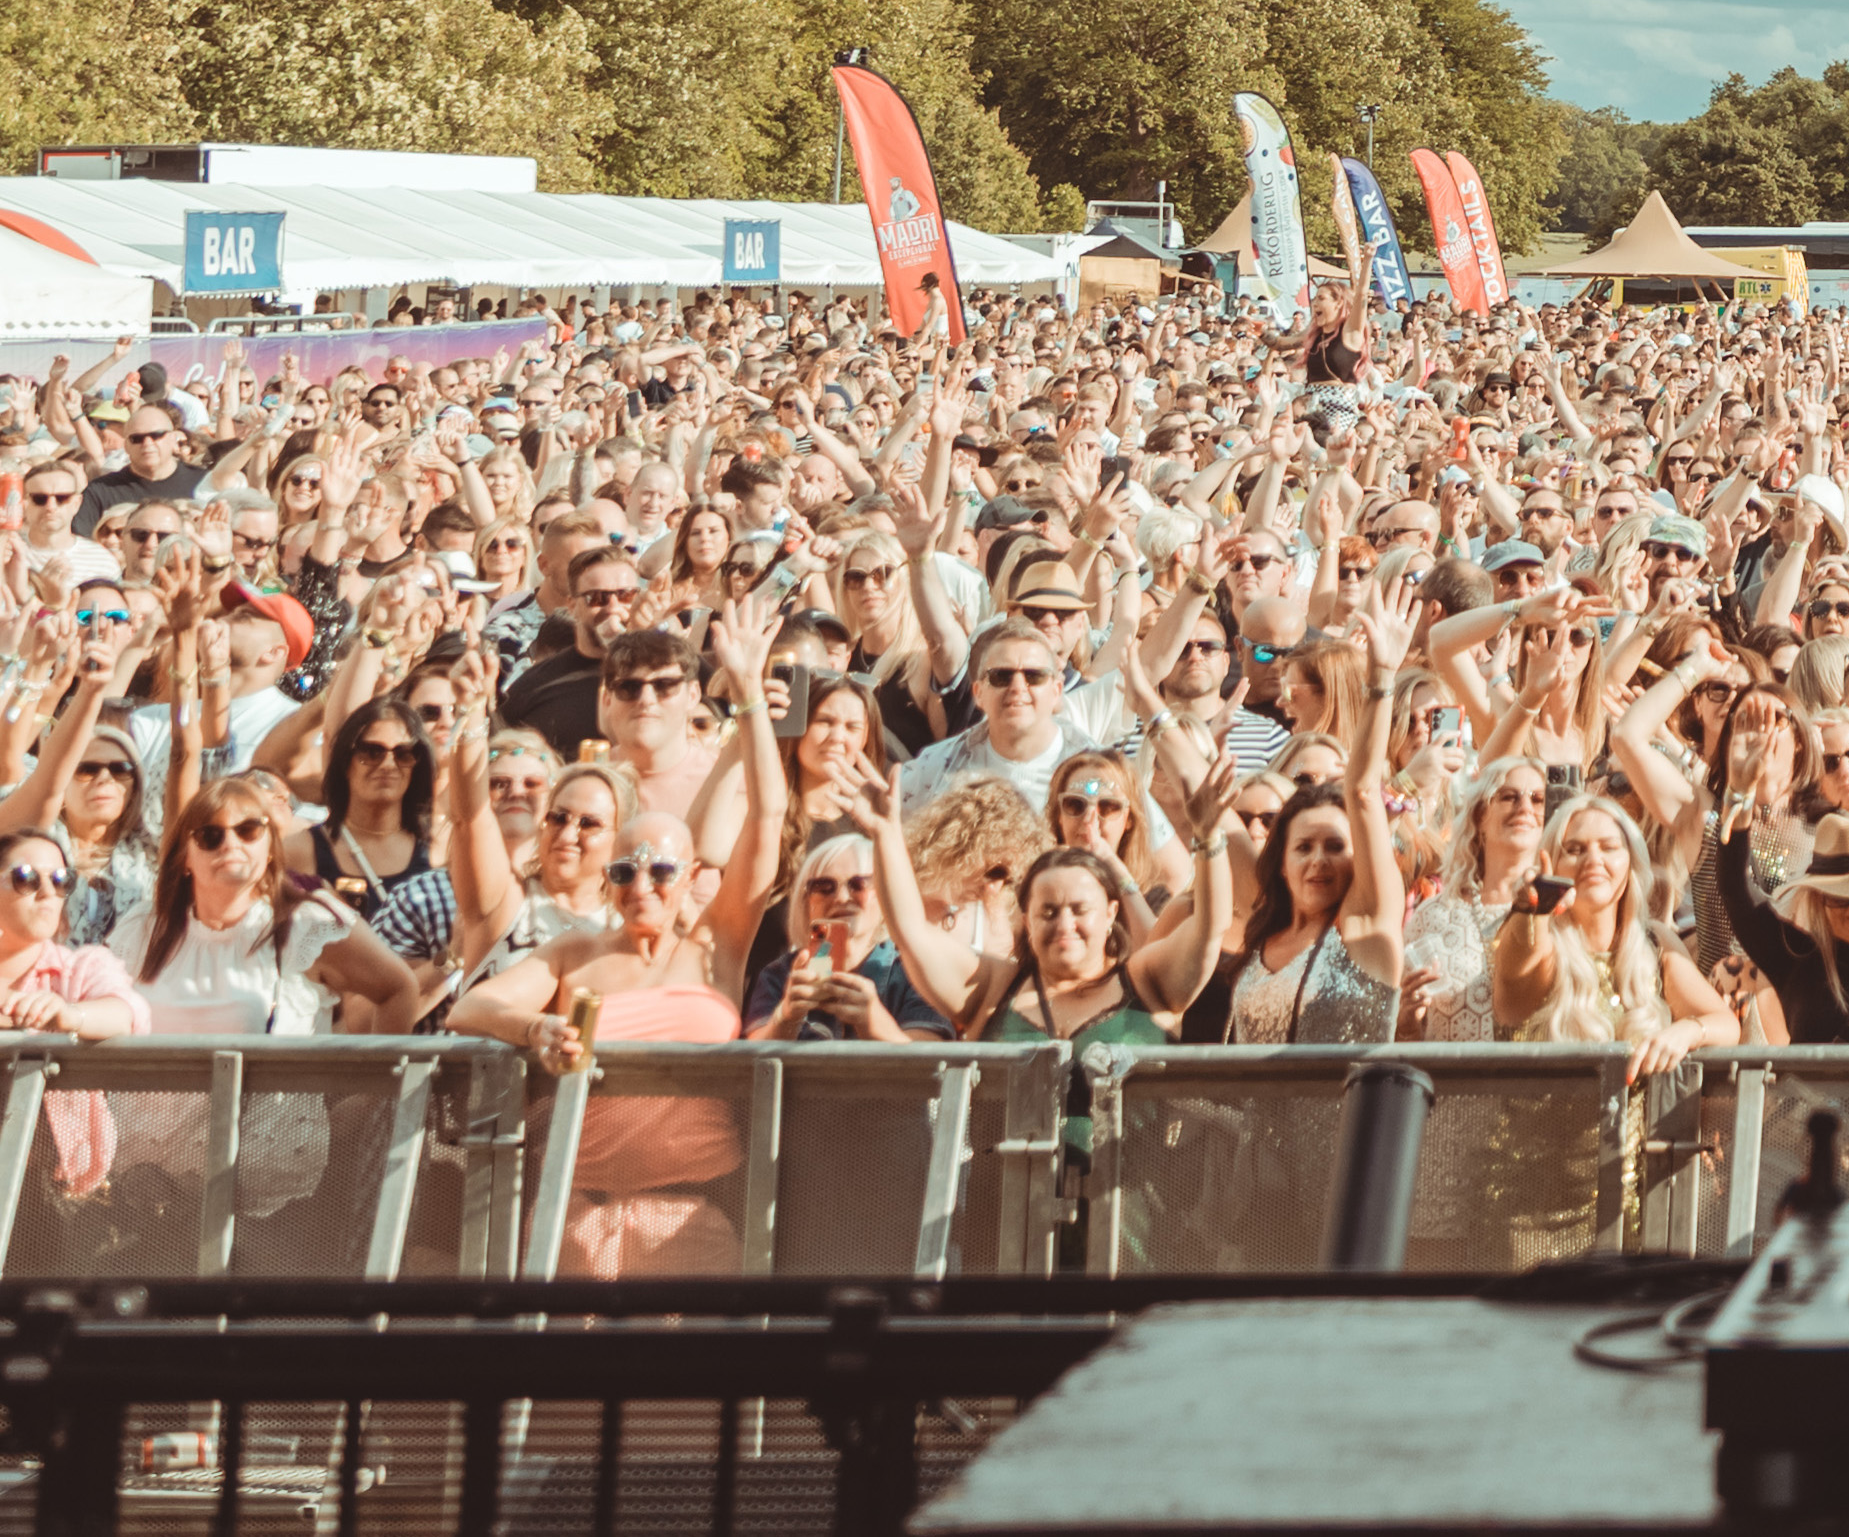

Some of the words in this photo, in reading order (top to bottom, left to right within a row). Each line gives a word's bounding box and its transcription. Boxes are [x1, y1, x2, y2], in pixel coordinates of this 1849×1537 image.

[1260, 170, 1284, 279] REKORDERLIG
[1361, 189, 1392, 248] BAR
[1461, 178, 1504, 308] OCKTAILS
[203, 226, 257, 276] BAR
[734, 231, 766, 270] BAR
[1376, 250, 1407, 310] IZZ
